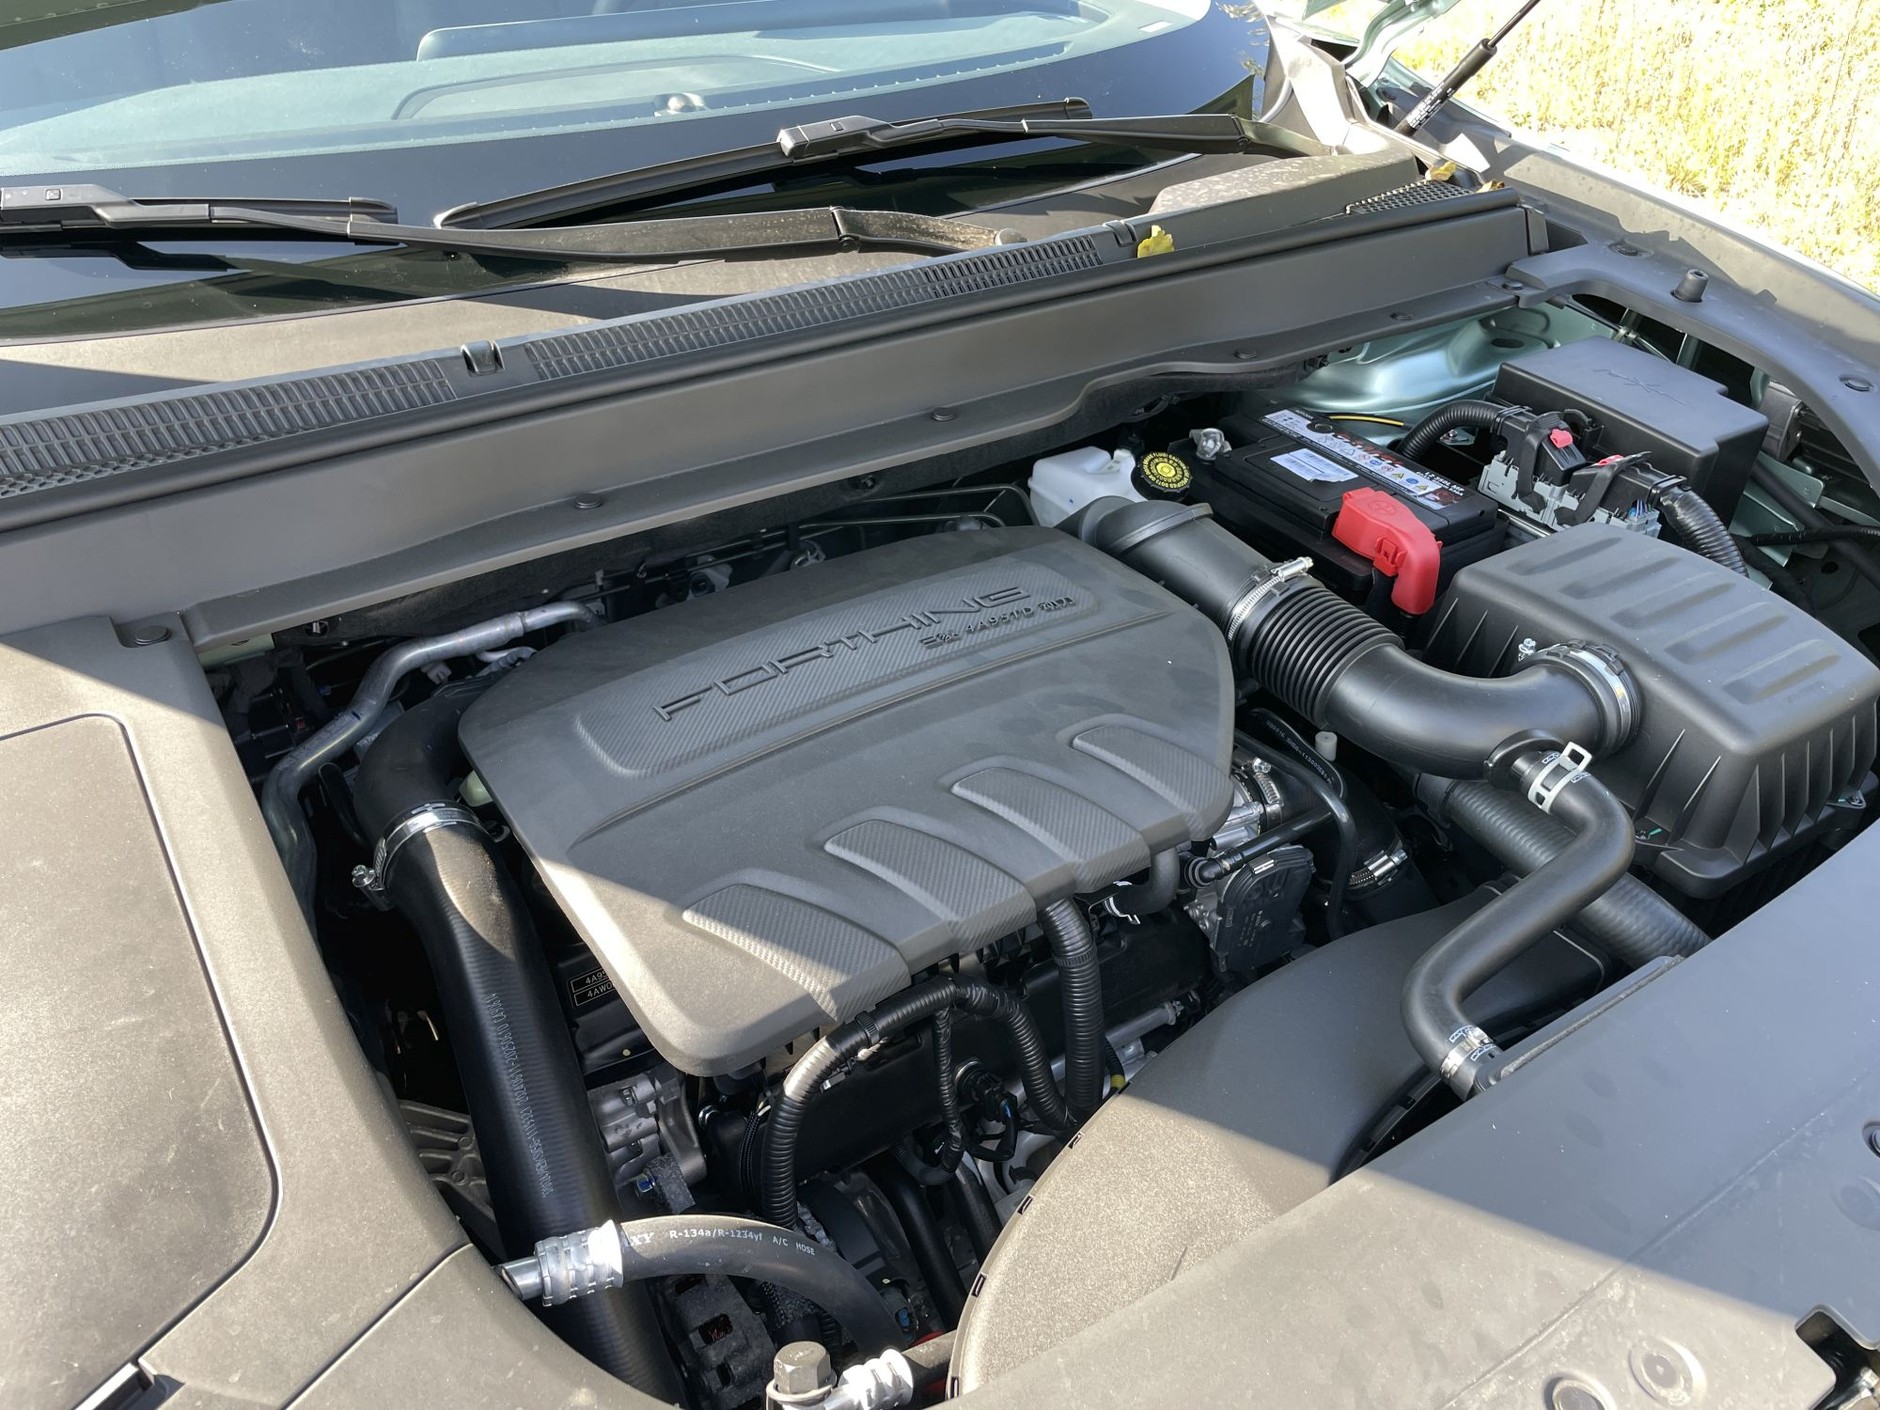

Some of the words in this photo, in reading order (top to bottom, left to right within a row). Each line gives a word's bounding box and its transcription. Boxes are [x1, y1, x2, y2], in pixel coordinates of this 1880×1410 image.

[964, 605, 1034, 632] 4A95TD
[652, 586, 1031, 722] FORTHING
[772, 1234, 788, 1247] A/C
[795, 1241, 816, 1256] HOSE
